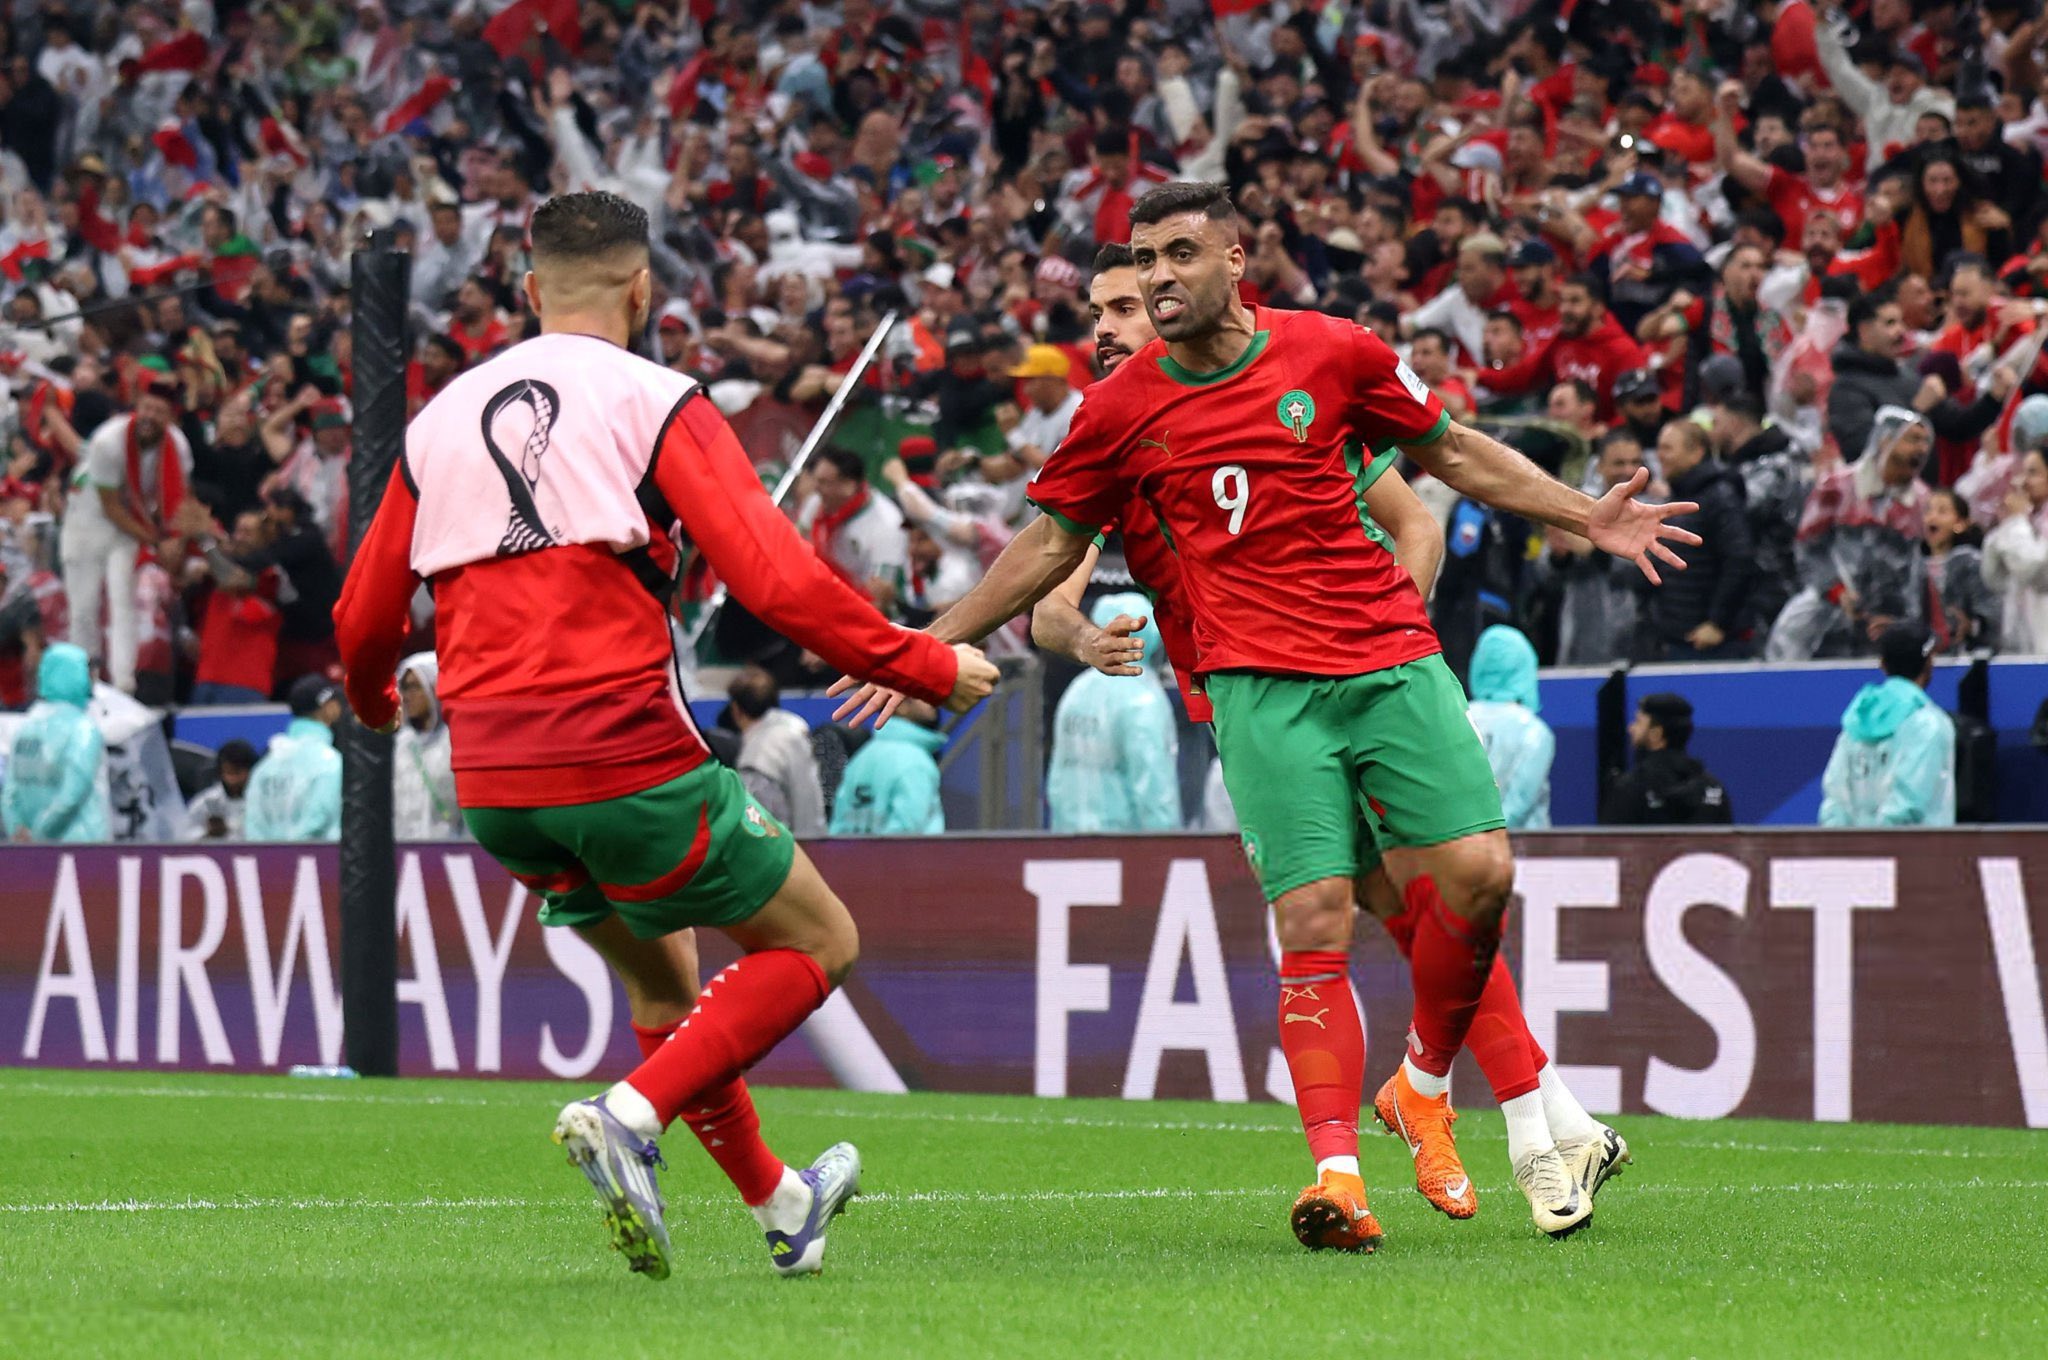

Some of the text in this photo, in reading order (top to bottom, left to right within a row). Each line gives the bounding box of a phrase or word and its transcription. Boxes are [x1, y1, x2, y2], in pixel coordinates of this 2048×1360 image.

[1212, 464, 1250, 535] 9
[22, 853, 613, 1078] AIRWAYS
[1023, 852, 1897, 1122] FAEST
